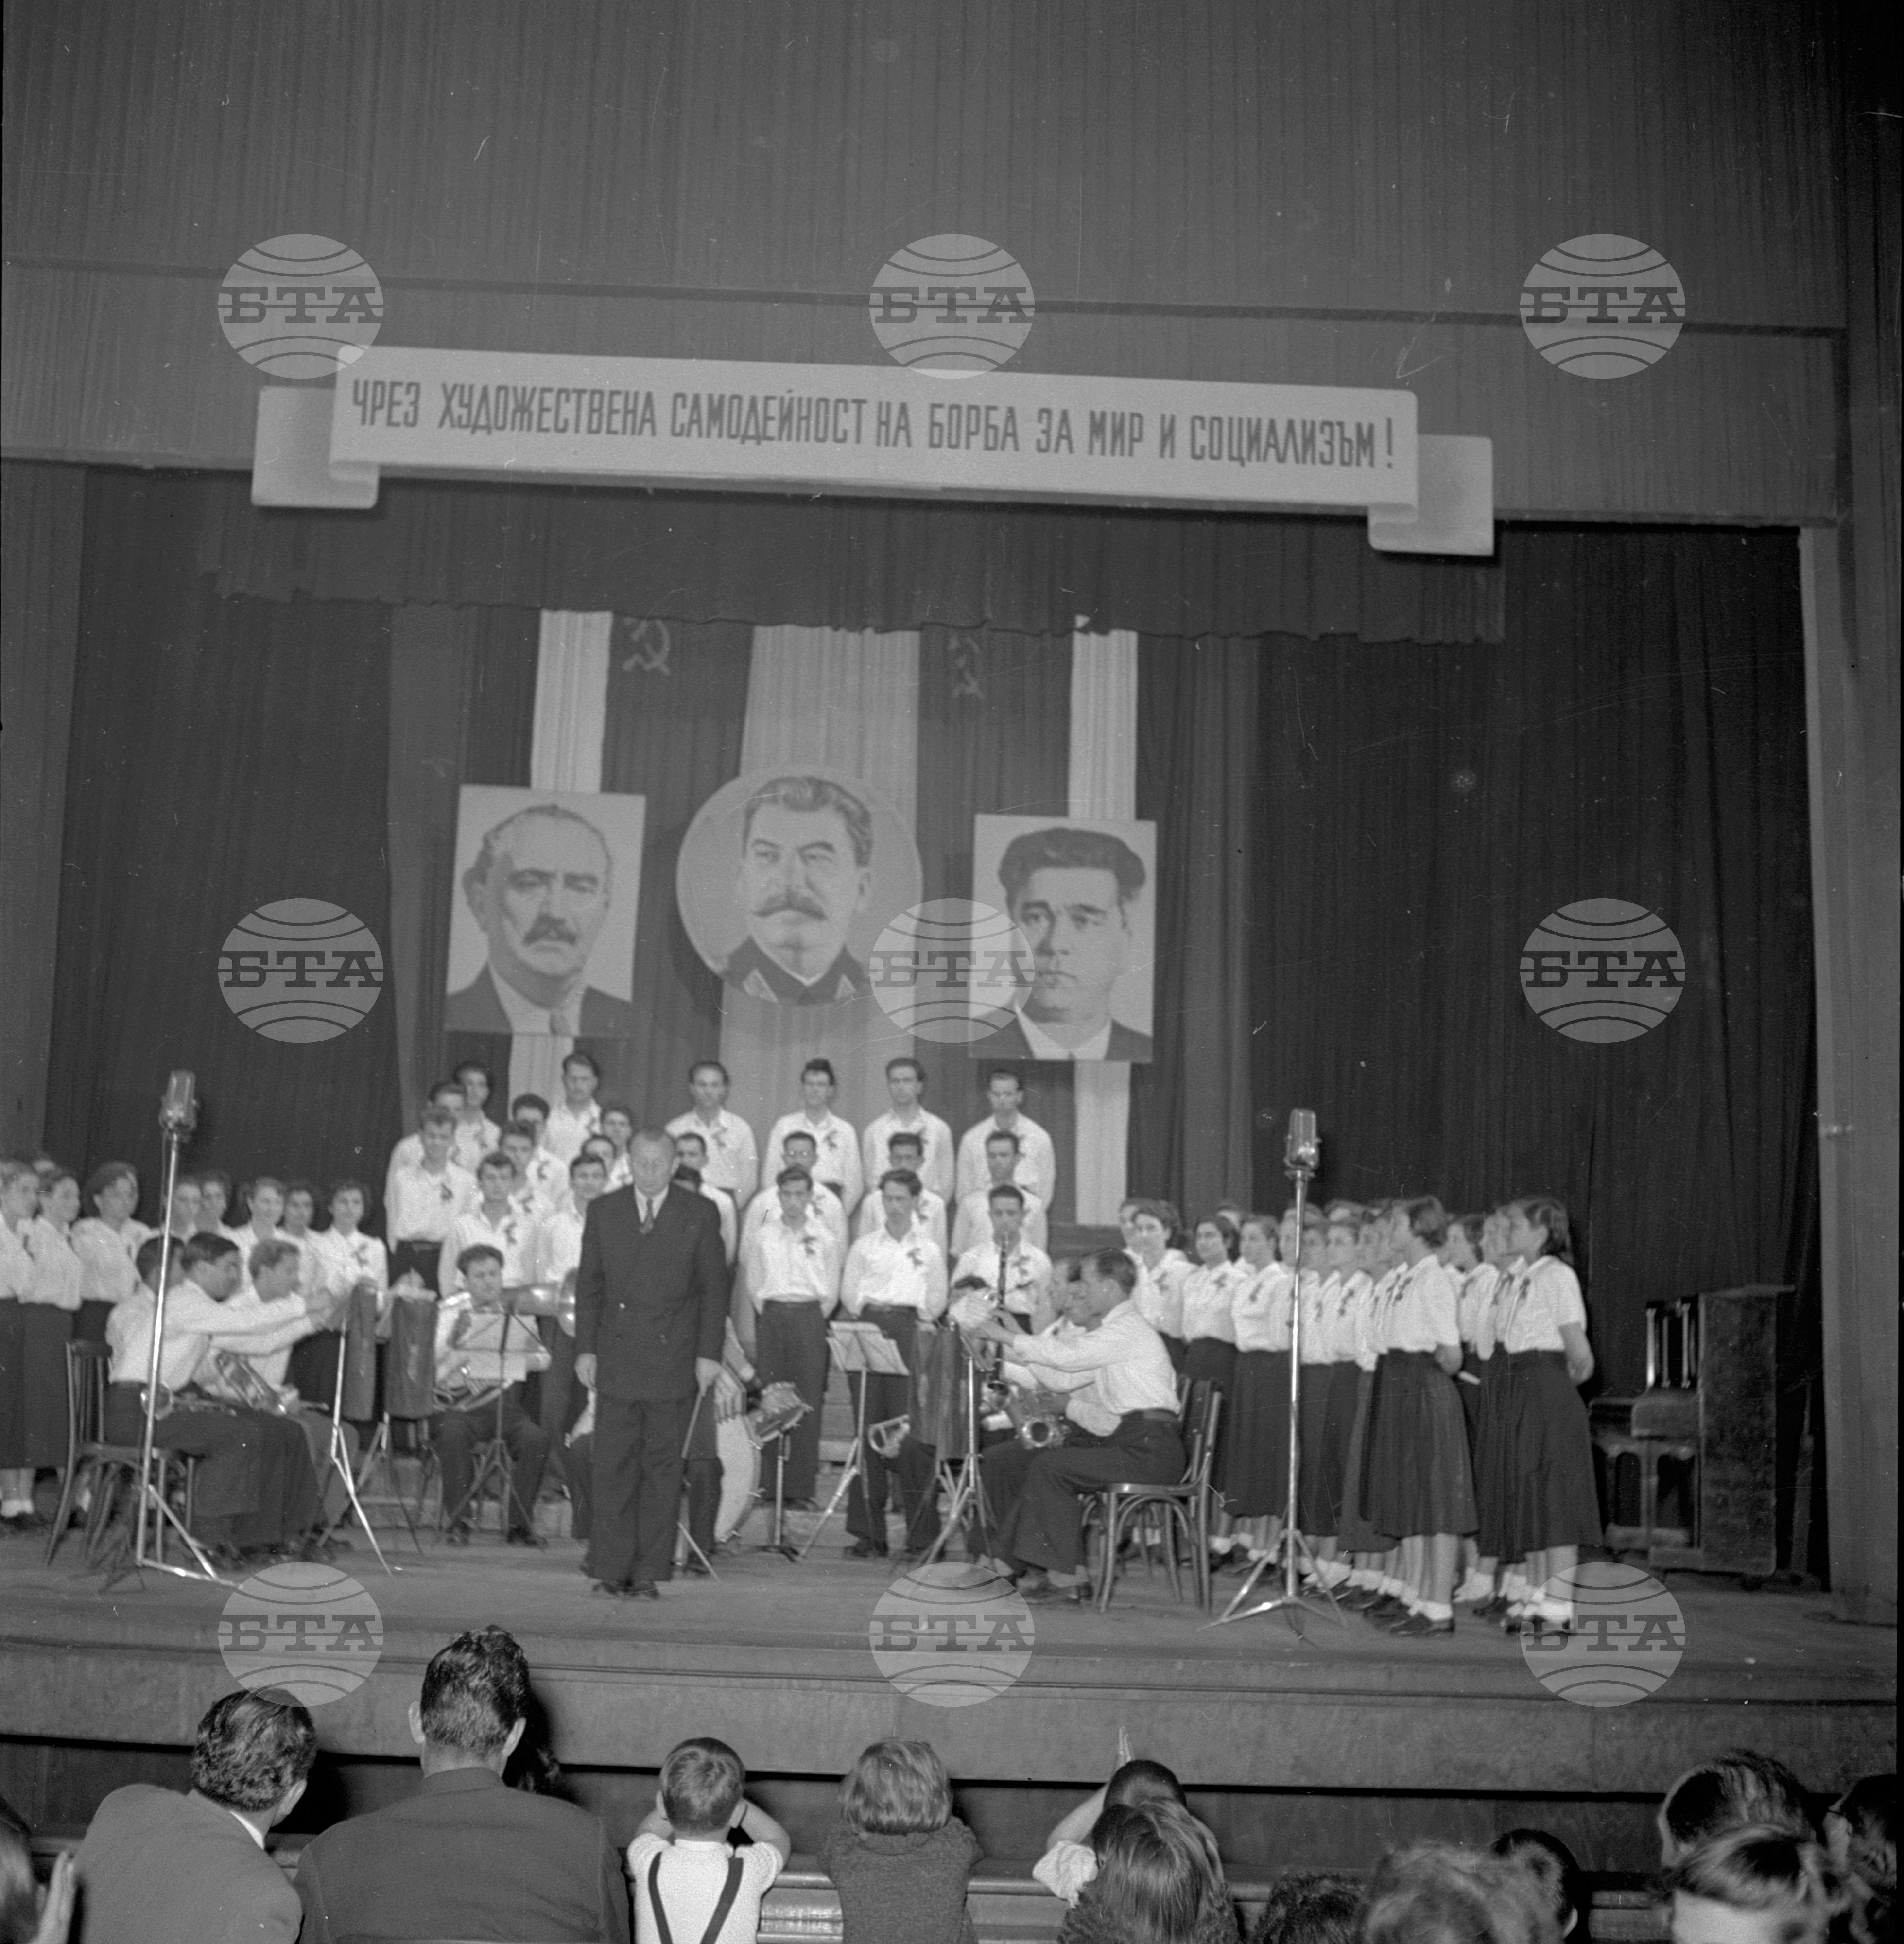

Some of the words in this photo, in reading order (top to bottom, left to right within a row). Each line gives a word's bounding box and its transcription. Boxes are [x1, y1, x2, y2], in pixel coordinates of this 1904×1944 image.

[352, 378, 421, 428] ЧРЕЗ
[438, 382, 657, 437] ХУДОЖЕСТВЕНА
[670, 388, 868, 446] САМОДЕЙНОСТ
[876, 400, 912, 448] НА
[928, 402, 1020, 452] БОРБА
[1036, 407, 1074, 455] ЗА
[1088, 410, 1144, 458] МИР
[1160, 413, 1176, 459] И
